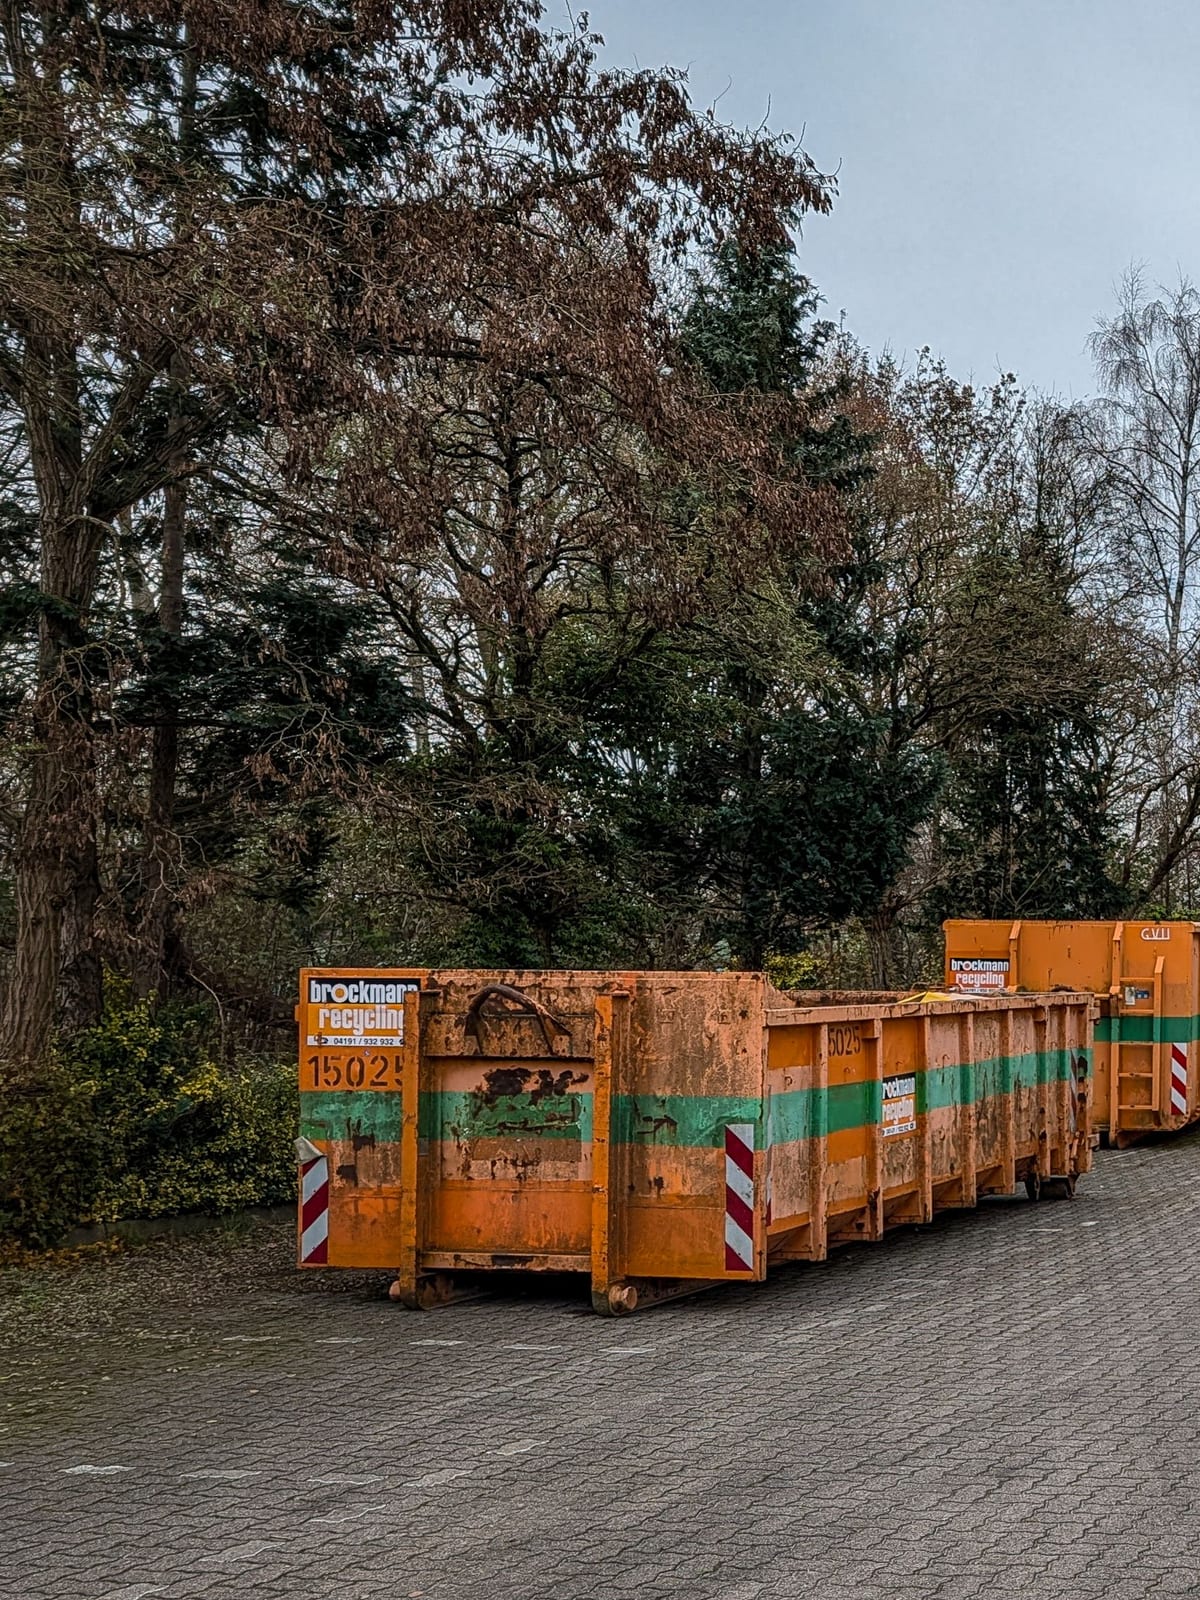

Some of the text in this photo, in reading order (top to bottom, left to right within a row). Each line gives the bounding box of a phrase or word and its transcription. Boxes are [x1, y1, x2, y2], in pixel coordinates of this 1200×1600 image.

[951, 959, 1009, 971] brockmann
[956, 971, 1005, 988] recycling
[333, 1037, 357, 1045] 04191
[363, 1037, 378, 1045] 932
[379, 1037, 394, 1045] 932
[828, 1025, 861, 1057] 5025
